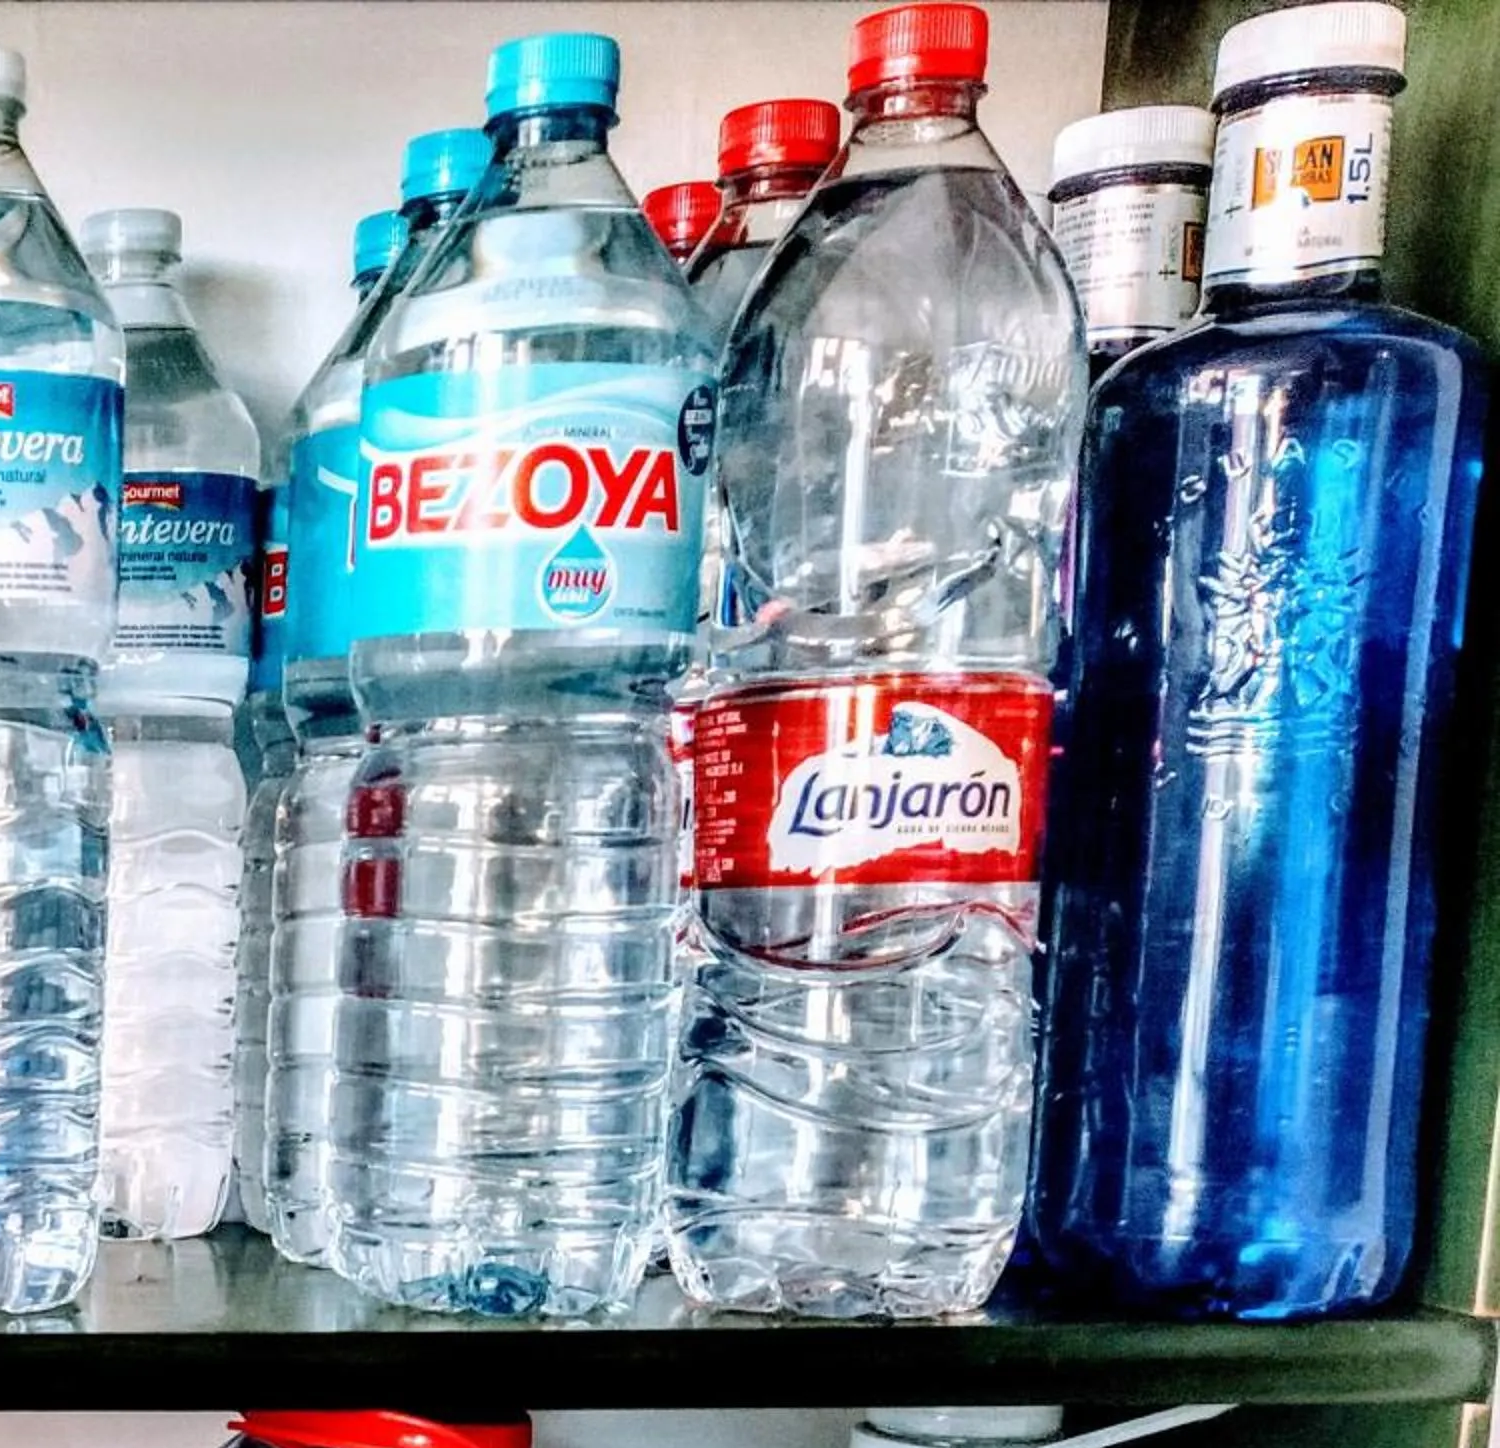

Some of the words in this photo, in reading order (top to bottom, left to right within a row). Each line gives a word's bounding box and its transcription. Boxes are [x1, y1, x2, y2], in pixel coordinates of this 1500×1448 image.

[1347, 133, 1373, 204] 1.5L
[368, 443, 680, 542] BEZOYA
[548, 568, 608, 597] muy
[788, 769, 1011, 838] Lanjarón
